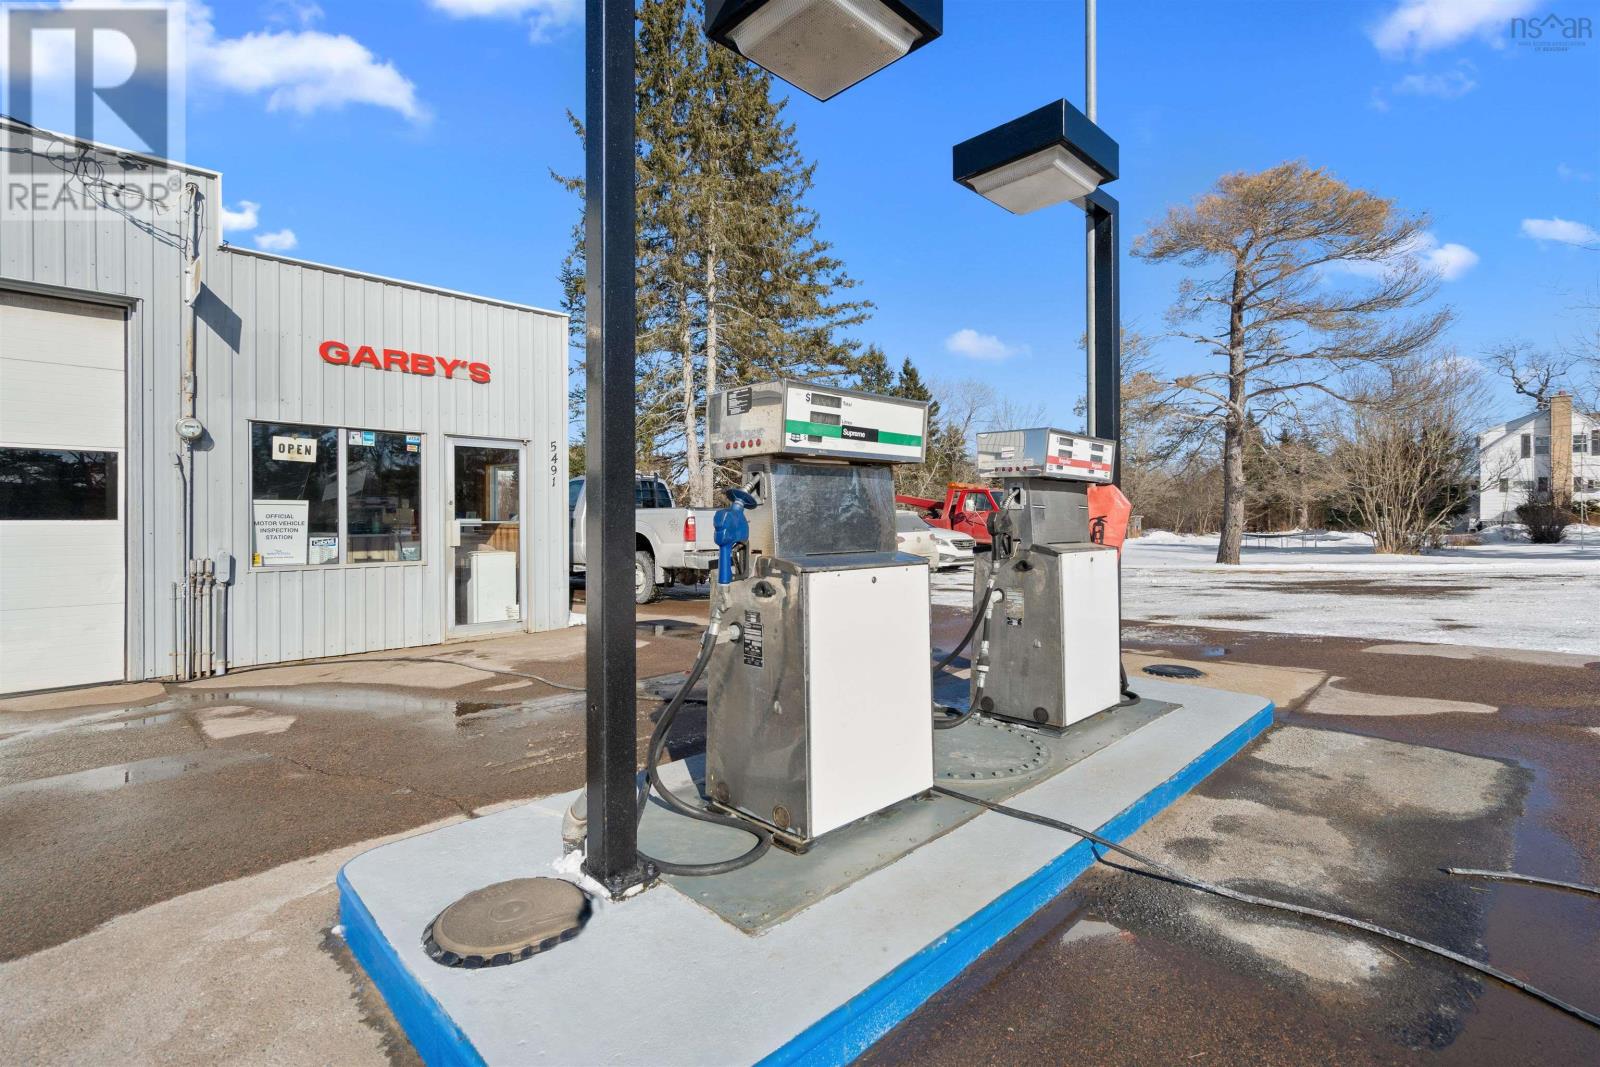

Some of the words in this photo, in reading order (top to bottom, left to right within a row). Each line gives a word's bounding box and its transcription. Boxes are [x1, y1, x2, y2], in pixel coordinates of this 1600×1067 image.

[319, 340, 491, 384] GARBY'S
[805, 393, 811, 402] $
[842, 428, 866, 438] Supreme
[278, 443, 312, 455] OPEN
[550, 440, 558, 487] 5491
